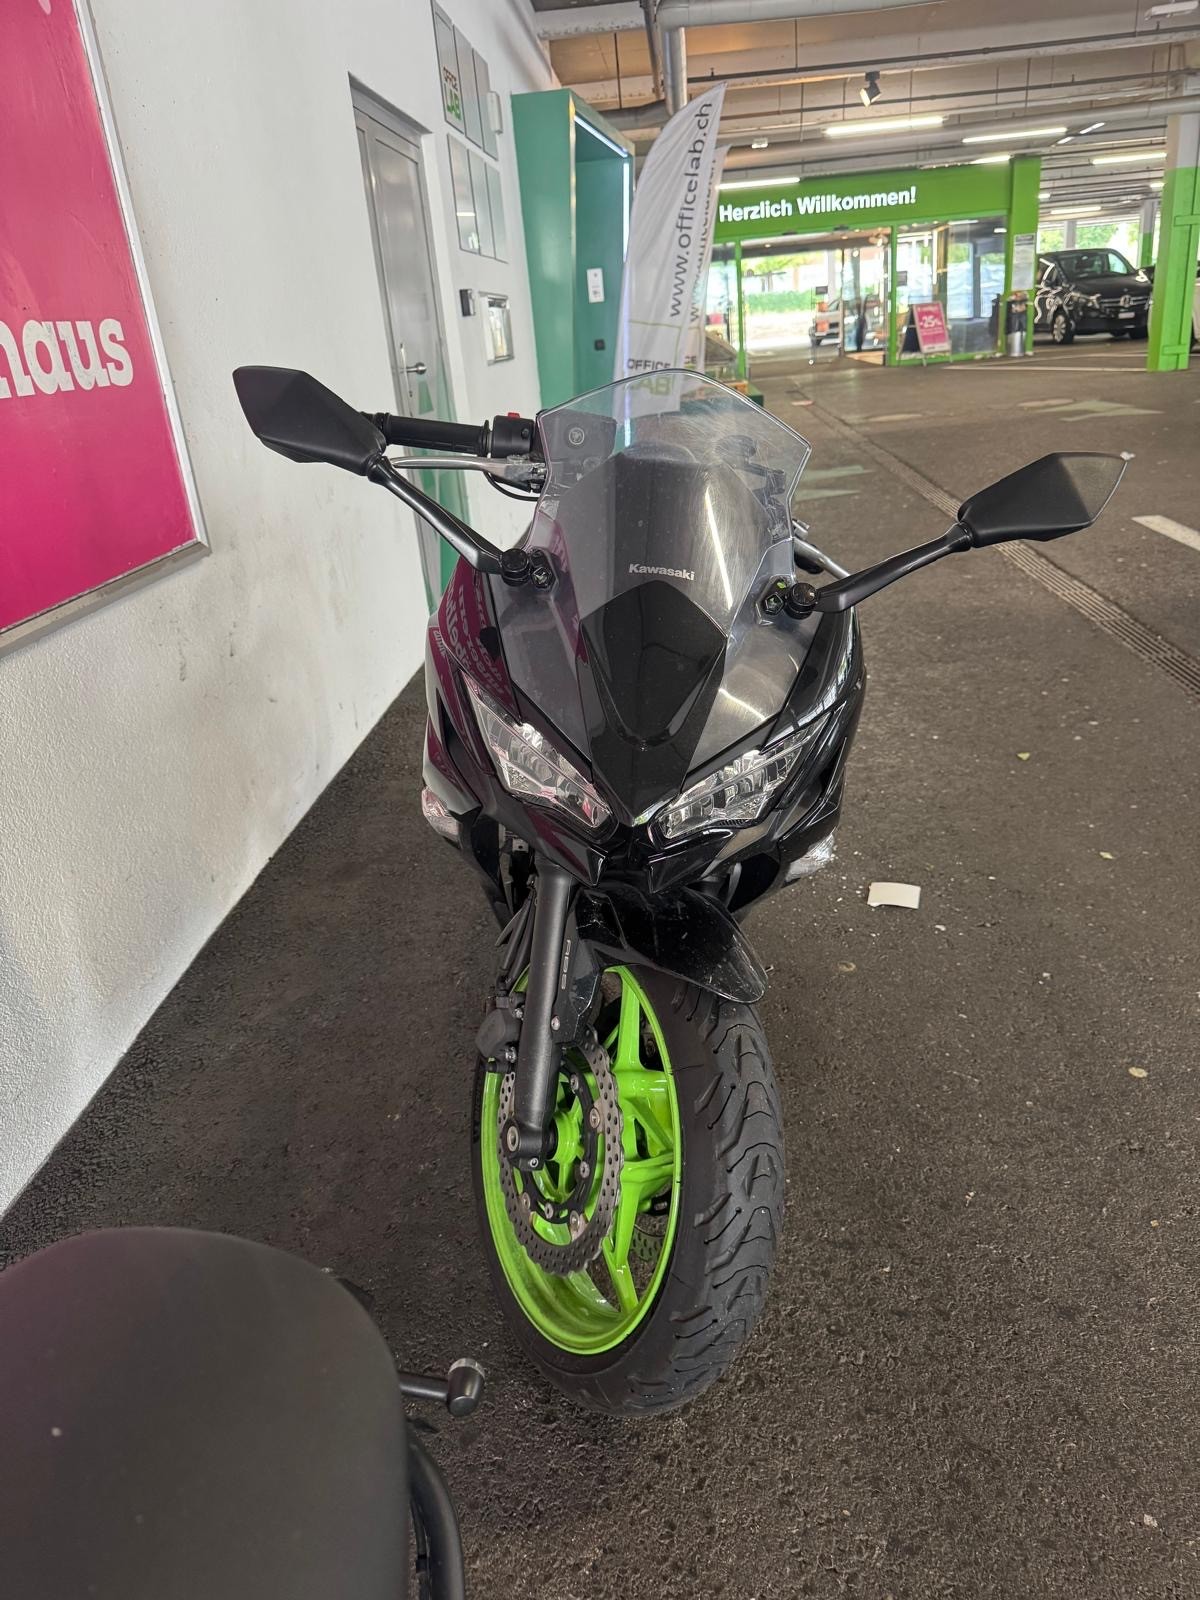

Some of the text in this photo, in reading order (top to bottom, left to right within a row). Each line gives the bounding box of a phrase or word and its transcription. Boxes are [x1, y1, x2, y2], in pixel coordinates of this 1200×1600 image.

[670, 102, 712, 317] www.officelab.ch
[719, 186, 917, 222] Herzlich Willkommen!
[629, 563, 695, 580] Kawasaki
